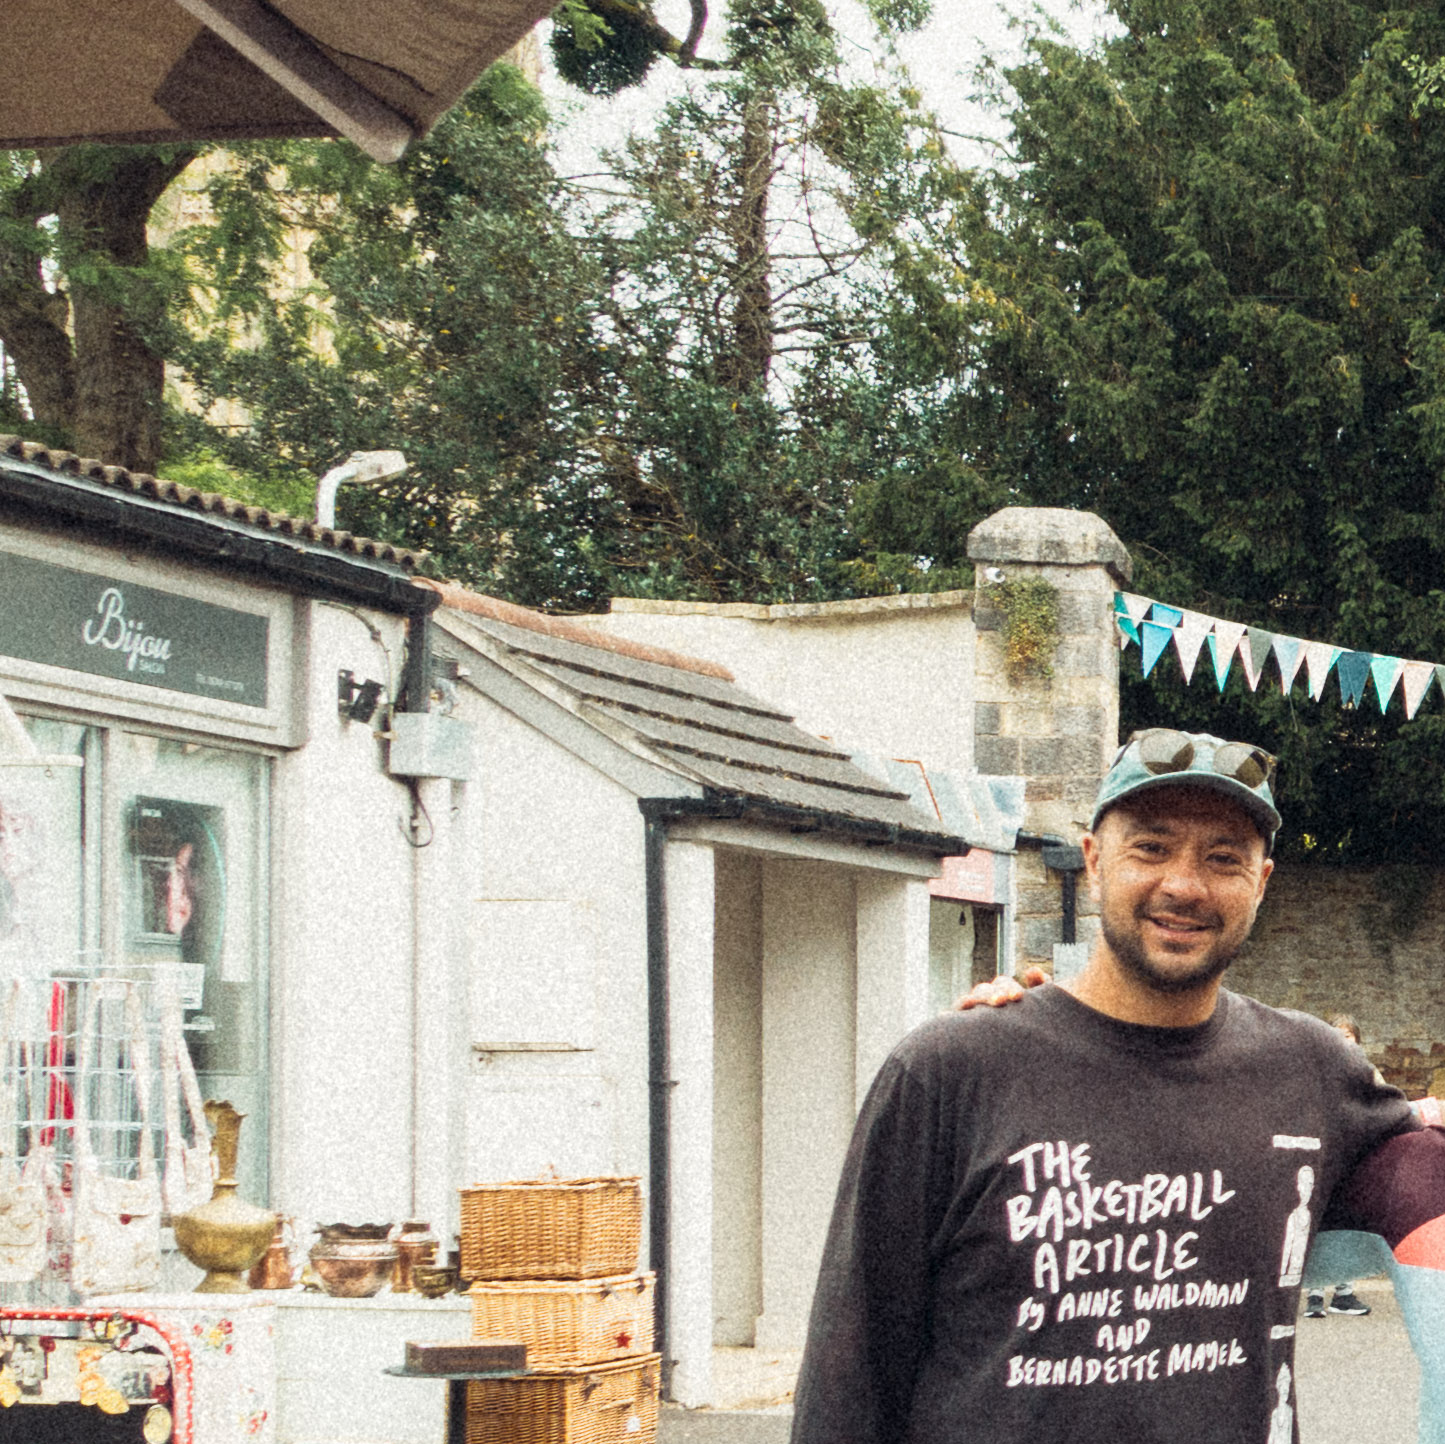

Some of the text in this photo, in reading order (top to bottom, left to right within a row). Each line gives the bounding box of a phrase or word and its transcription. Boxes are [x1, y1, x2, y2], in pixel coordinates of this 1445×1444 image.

[83, 587, 172, 671] Bijou
[1007, 1141, 1092, 1193] THE
[1006, 1170, 1237, 1242] BASKETBALL
[1034, 1229, 1200, 1295] ARTICLE
[1056, 1288, 1124, 1323] ANNE
[1134, 1278, 1250, 1312] WALDMAN
[1096, 1318, 1152, 1352] AND
[1006, 1349, 1161, 1388] BERNADETTE
